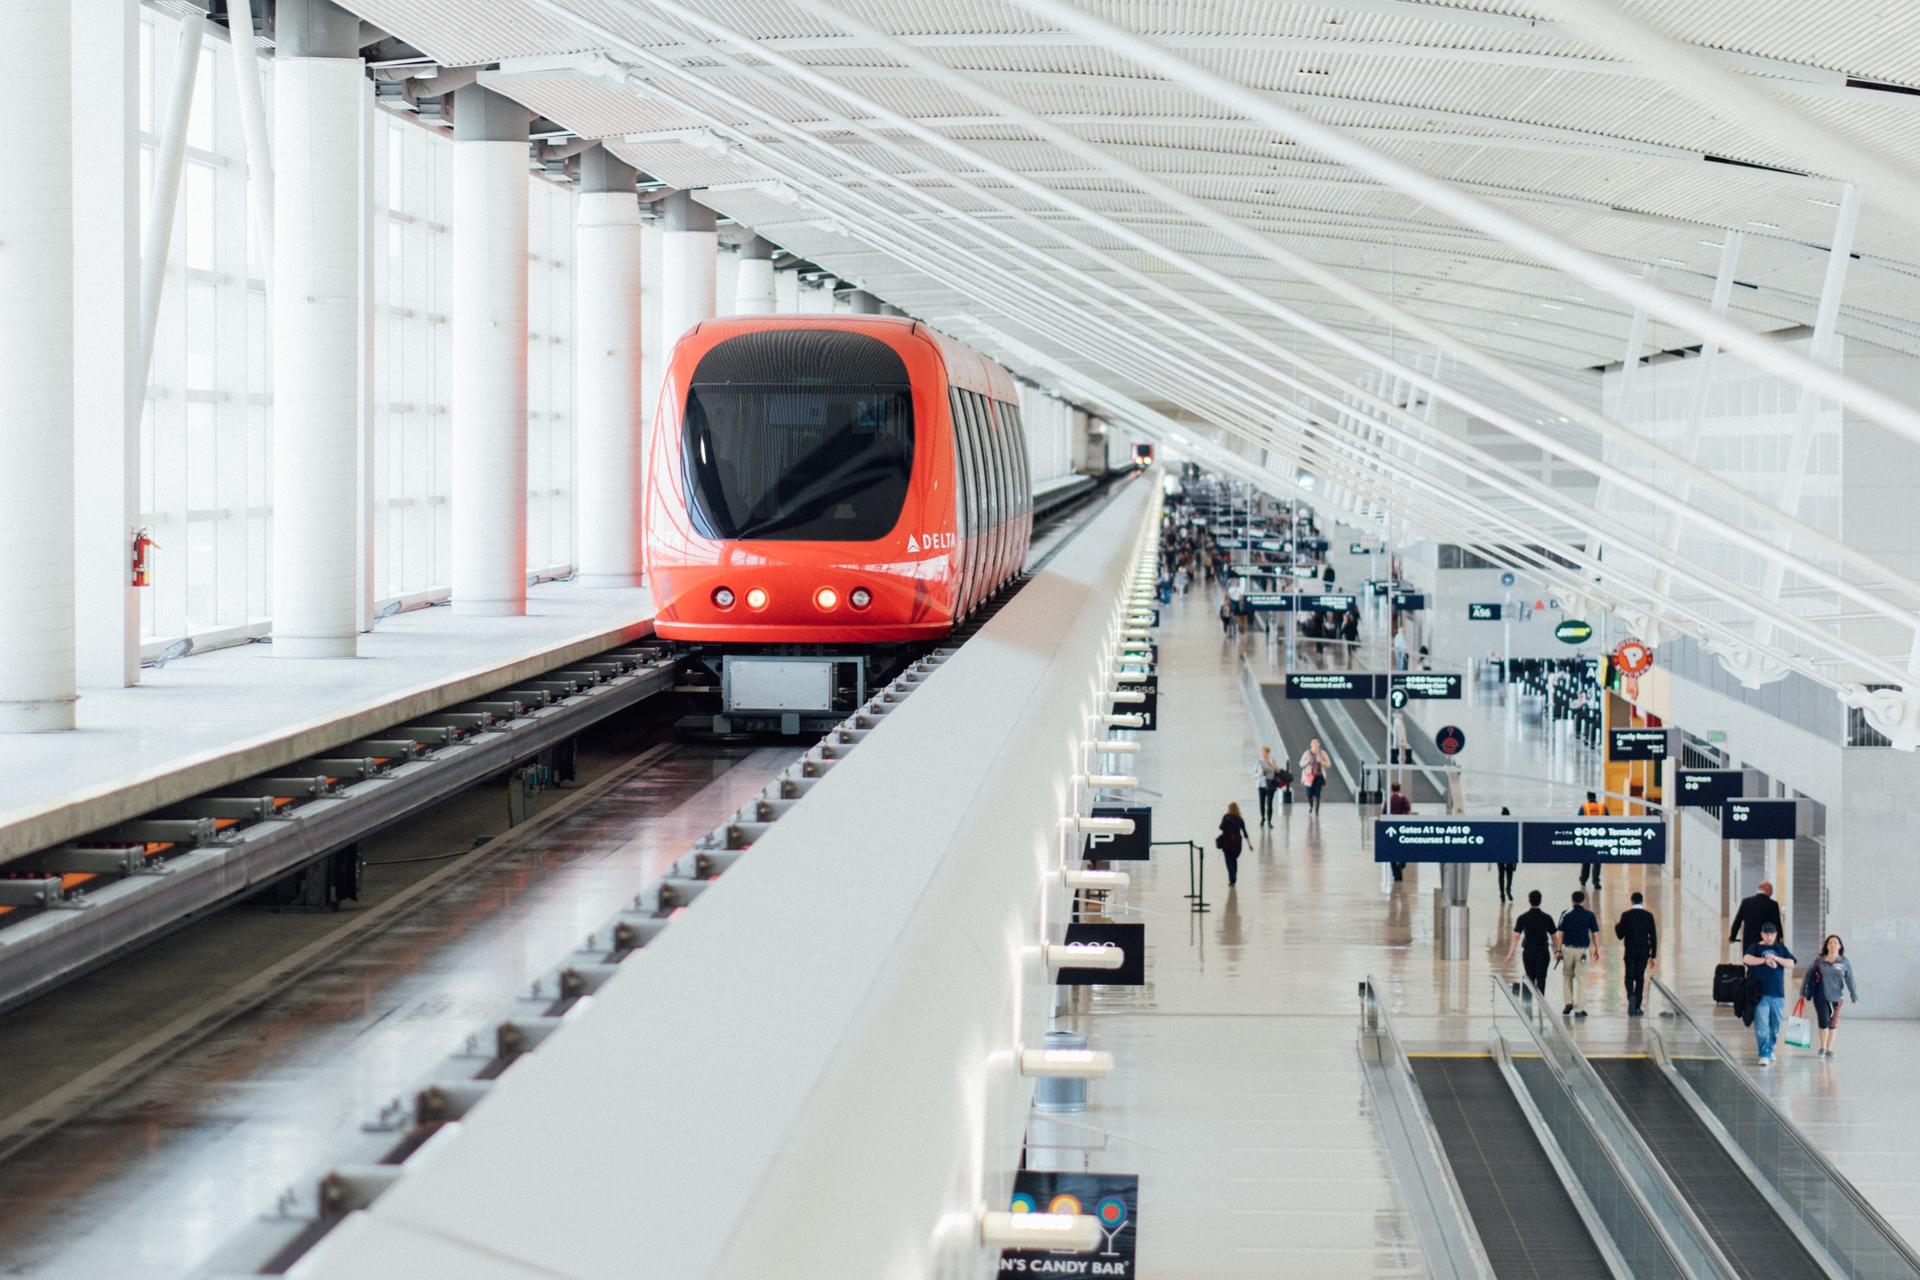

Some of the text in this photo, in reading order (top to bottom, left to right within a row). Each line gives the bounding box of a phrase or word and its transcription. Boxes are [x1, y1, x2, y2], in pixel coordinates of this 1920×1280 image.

[1733, 805, 1750, 813] Men
[1399, 826, 1422, 834] Gates
[1423, 826, 1433, 834] A1
[1436, 826, 1445, 834] to
[1608, 828, 1642, 836] Terminal
[1399, 836, 1443, 844] Concourses
[1452, 836, 1467, 844] and
[1584, 838, 1642, 847] Luggage Claim
[1619, 848, 1641, 856] Hotel
[998, 1258, 1125, 1275] N'S CANDY BAR
